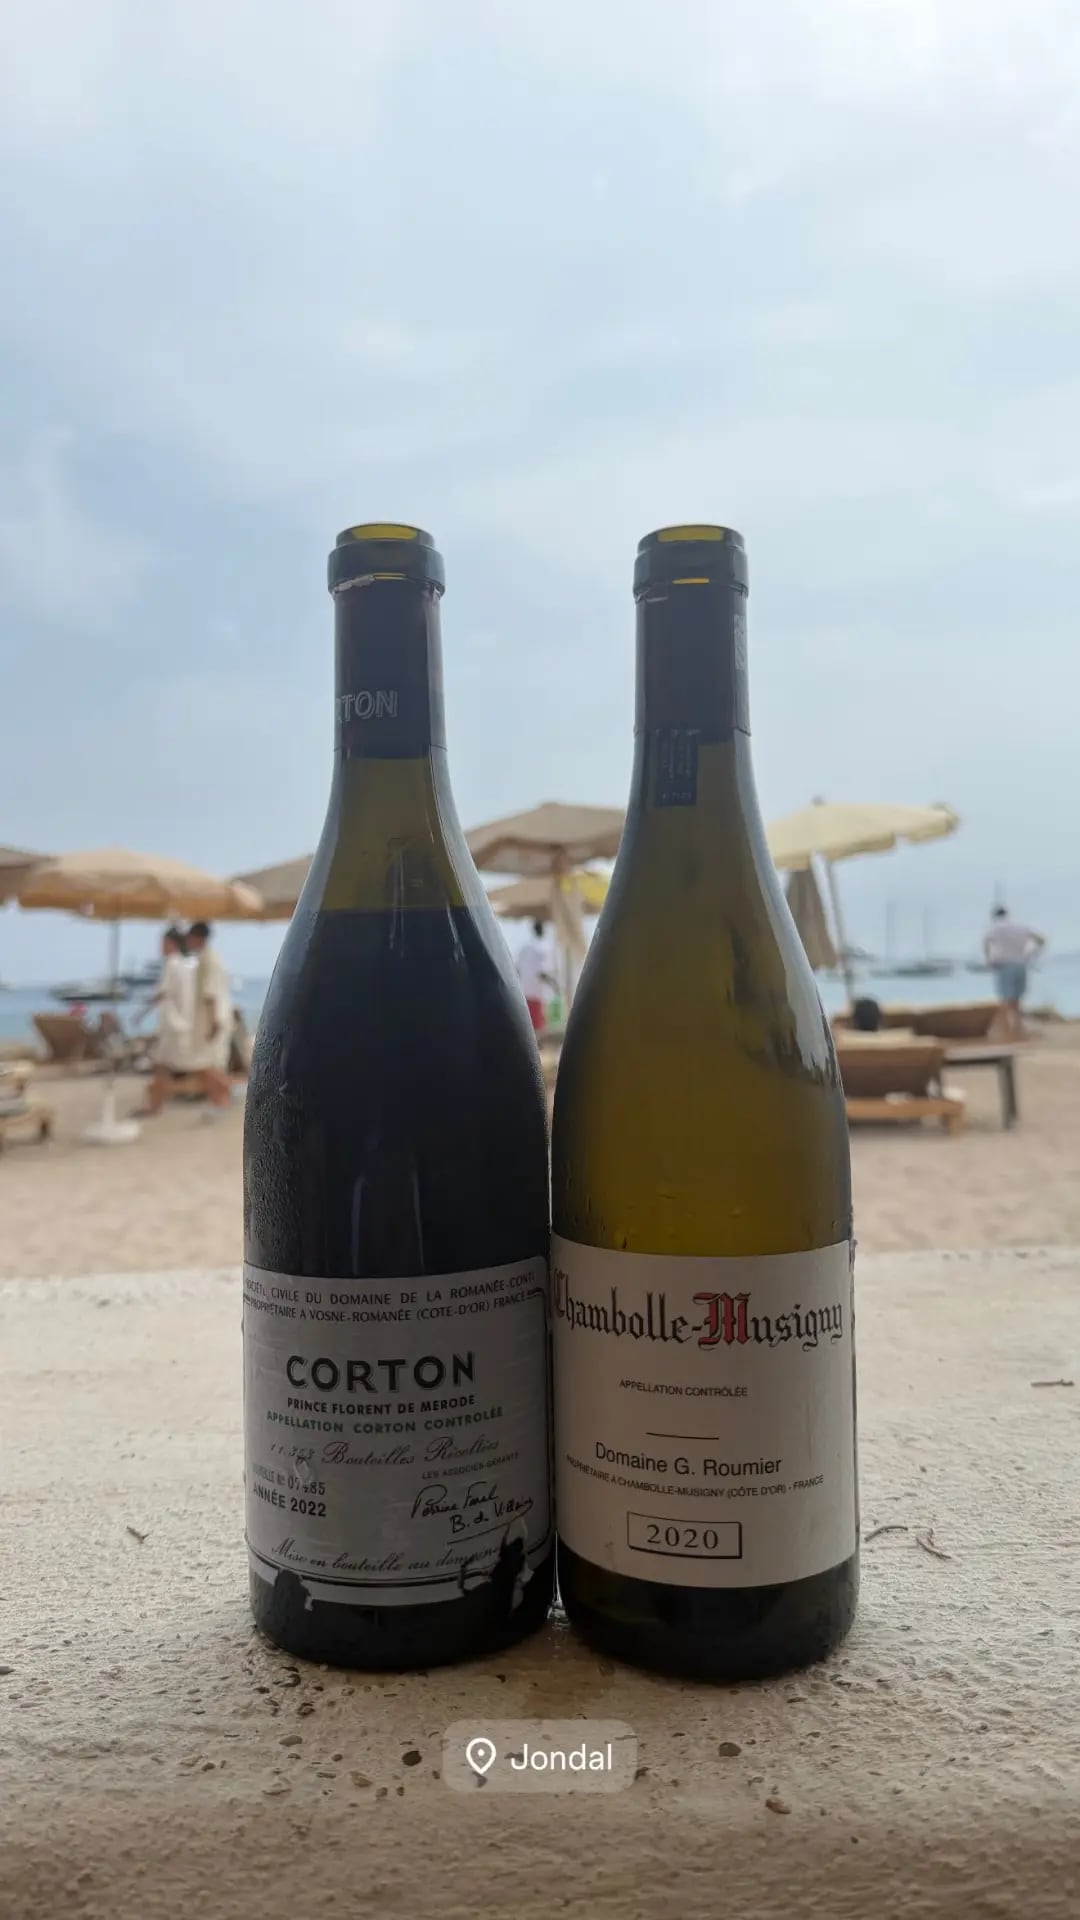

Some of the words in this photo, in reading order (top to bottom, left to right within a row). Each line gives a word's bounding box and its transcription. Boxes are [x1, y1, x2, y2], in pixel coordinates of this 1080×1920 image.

[271, 1287, 300, 1303] CIVILE
[305, 1291, 322, 1304] DU
[329, 1292, 393, 1305] DOMAINE
[400, 1291, 417, 1304] DE
[426, 1290, 442, 1302] LA
[310, 1309, 412, 1323] VOSNE-ROMANÉE
[493, 1290, 527, 1309] FRANCE
[553, 1267, 844, 1352] Chambolle-Musigny
[285, 1351, 477, 1394] CORTON
[619, 1379, 683, 1397] APPELLATION
[685, 1384, 748, 1397] CONTRÔLÉE
[287, 1396, 328, 1414] PRINCE
[332, 1400, 392, 1416] FLORENT
[397, 1400, 416, 1415] DE
[420, 1394, 476, 1413] MERODE
[266, 1410, 344, 1433] APPELLATION
[353, 1420, 417, 1434] CORTON
[321, 1441, 416, 1466] Bouteilles
[595, 1441, 668, 1474] Domaine
[674, 1457, 696, 1475] G.
[703, 1458, 782, 1476] Roumier
[421, 1470, 440, 1480] LES
[618, 1476, 727, 1498] CHAMBOLLE-MUSIGNY
[727, 1484, 759, 1500] (CÔTE
[760, 1483, 787, 1497] D'OR)
[793, 1475, 825, 1491] FRANCE
[252, 1482, 287, 1509] ANNÉE
[290, 1497, 327, 1518] 2022
[646, 1523, 719, 1550] 2020
[271, 1537, 308, 1562] Mise
[310, 1558, 329, 1569] en
[408, 1559, 432, 1570] au
